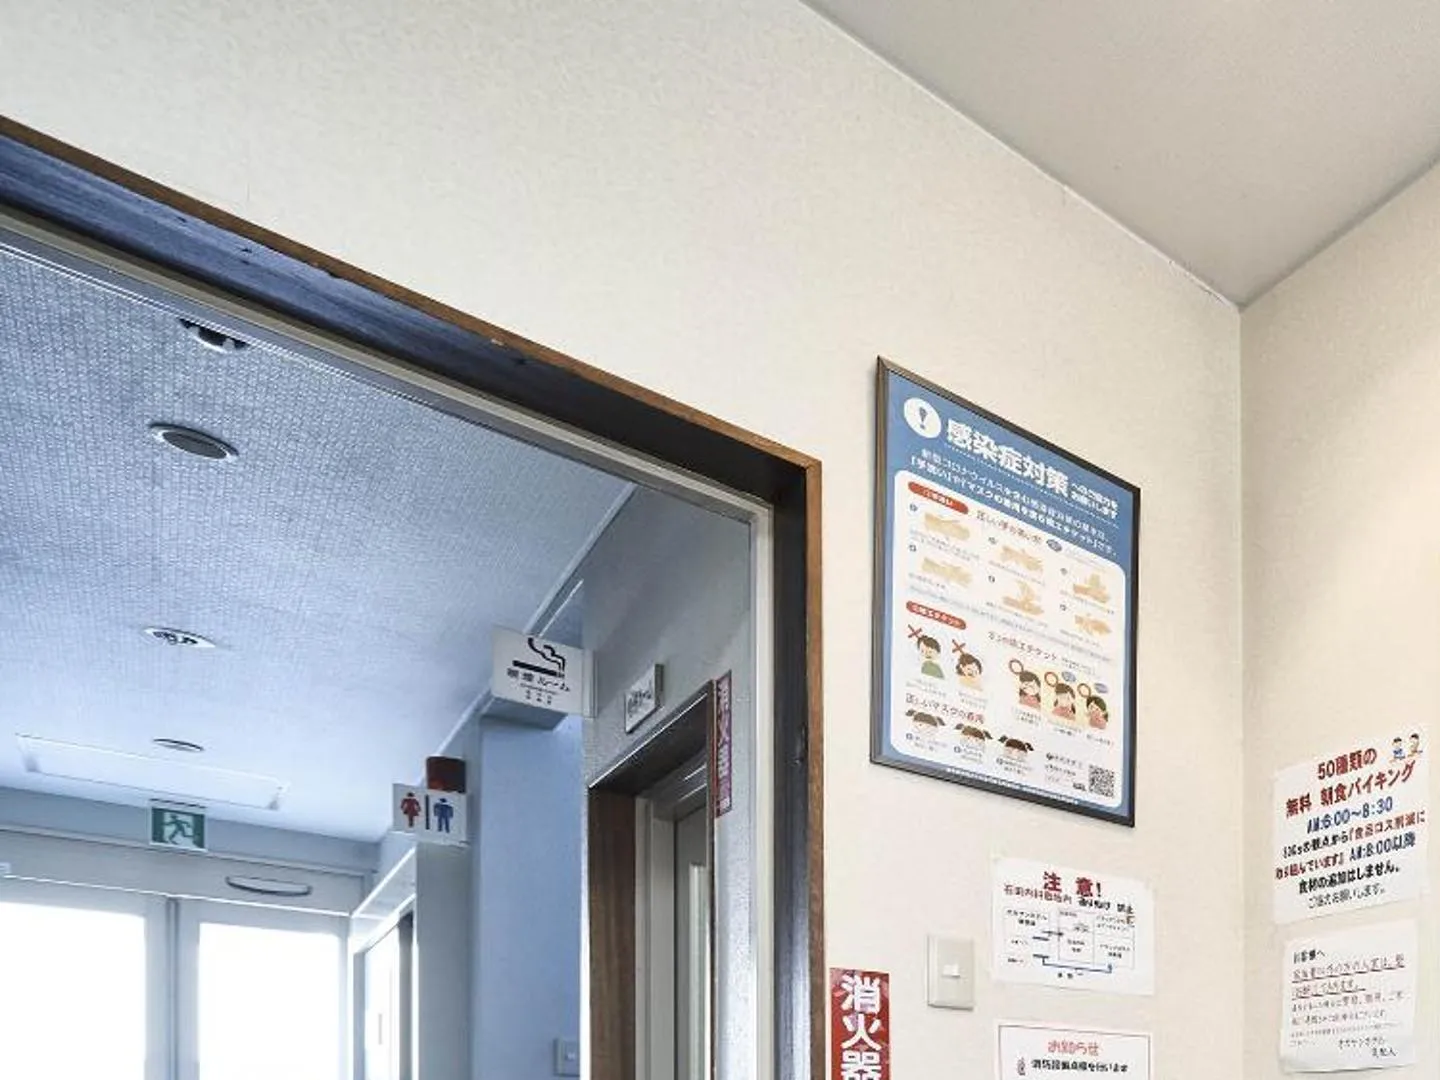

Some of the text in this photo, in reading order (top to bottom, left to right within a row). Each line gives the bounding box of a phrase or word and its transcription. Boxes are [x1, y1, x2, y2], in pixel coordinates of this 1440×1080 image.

[947, 418, 1068, 497] 感染症対策
[1286, 760, 1416, 818] 無料 朝食バイキング
[1318, 748, 1377, 780] 50種類の
